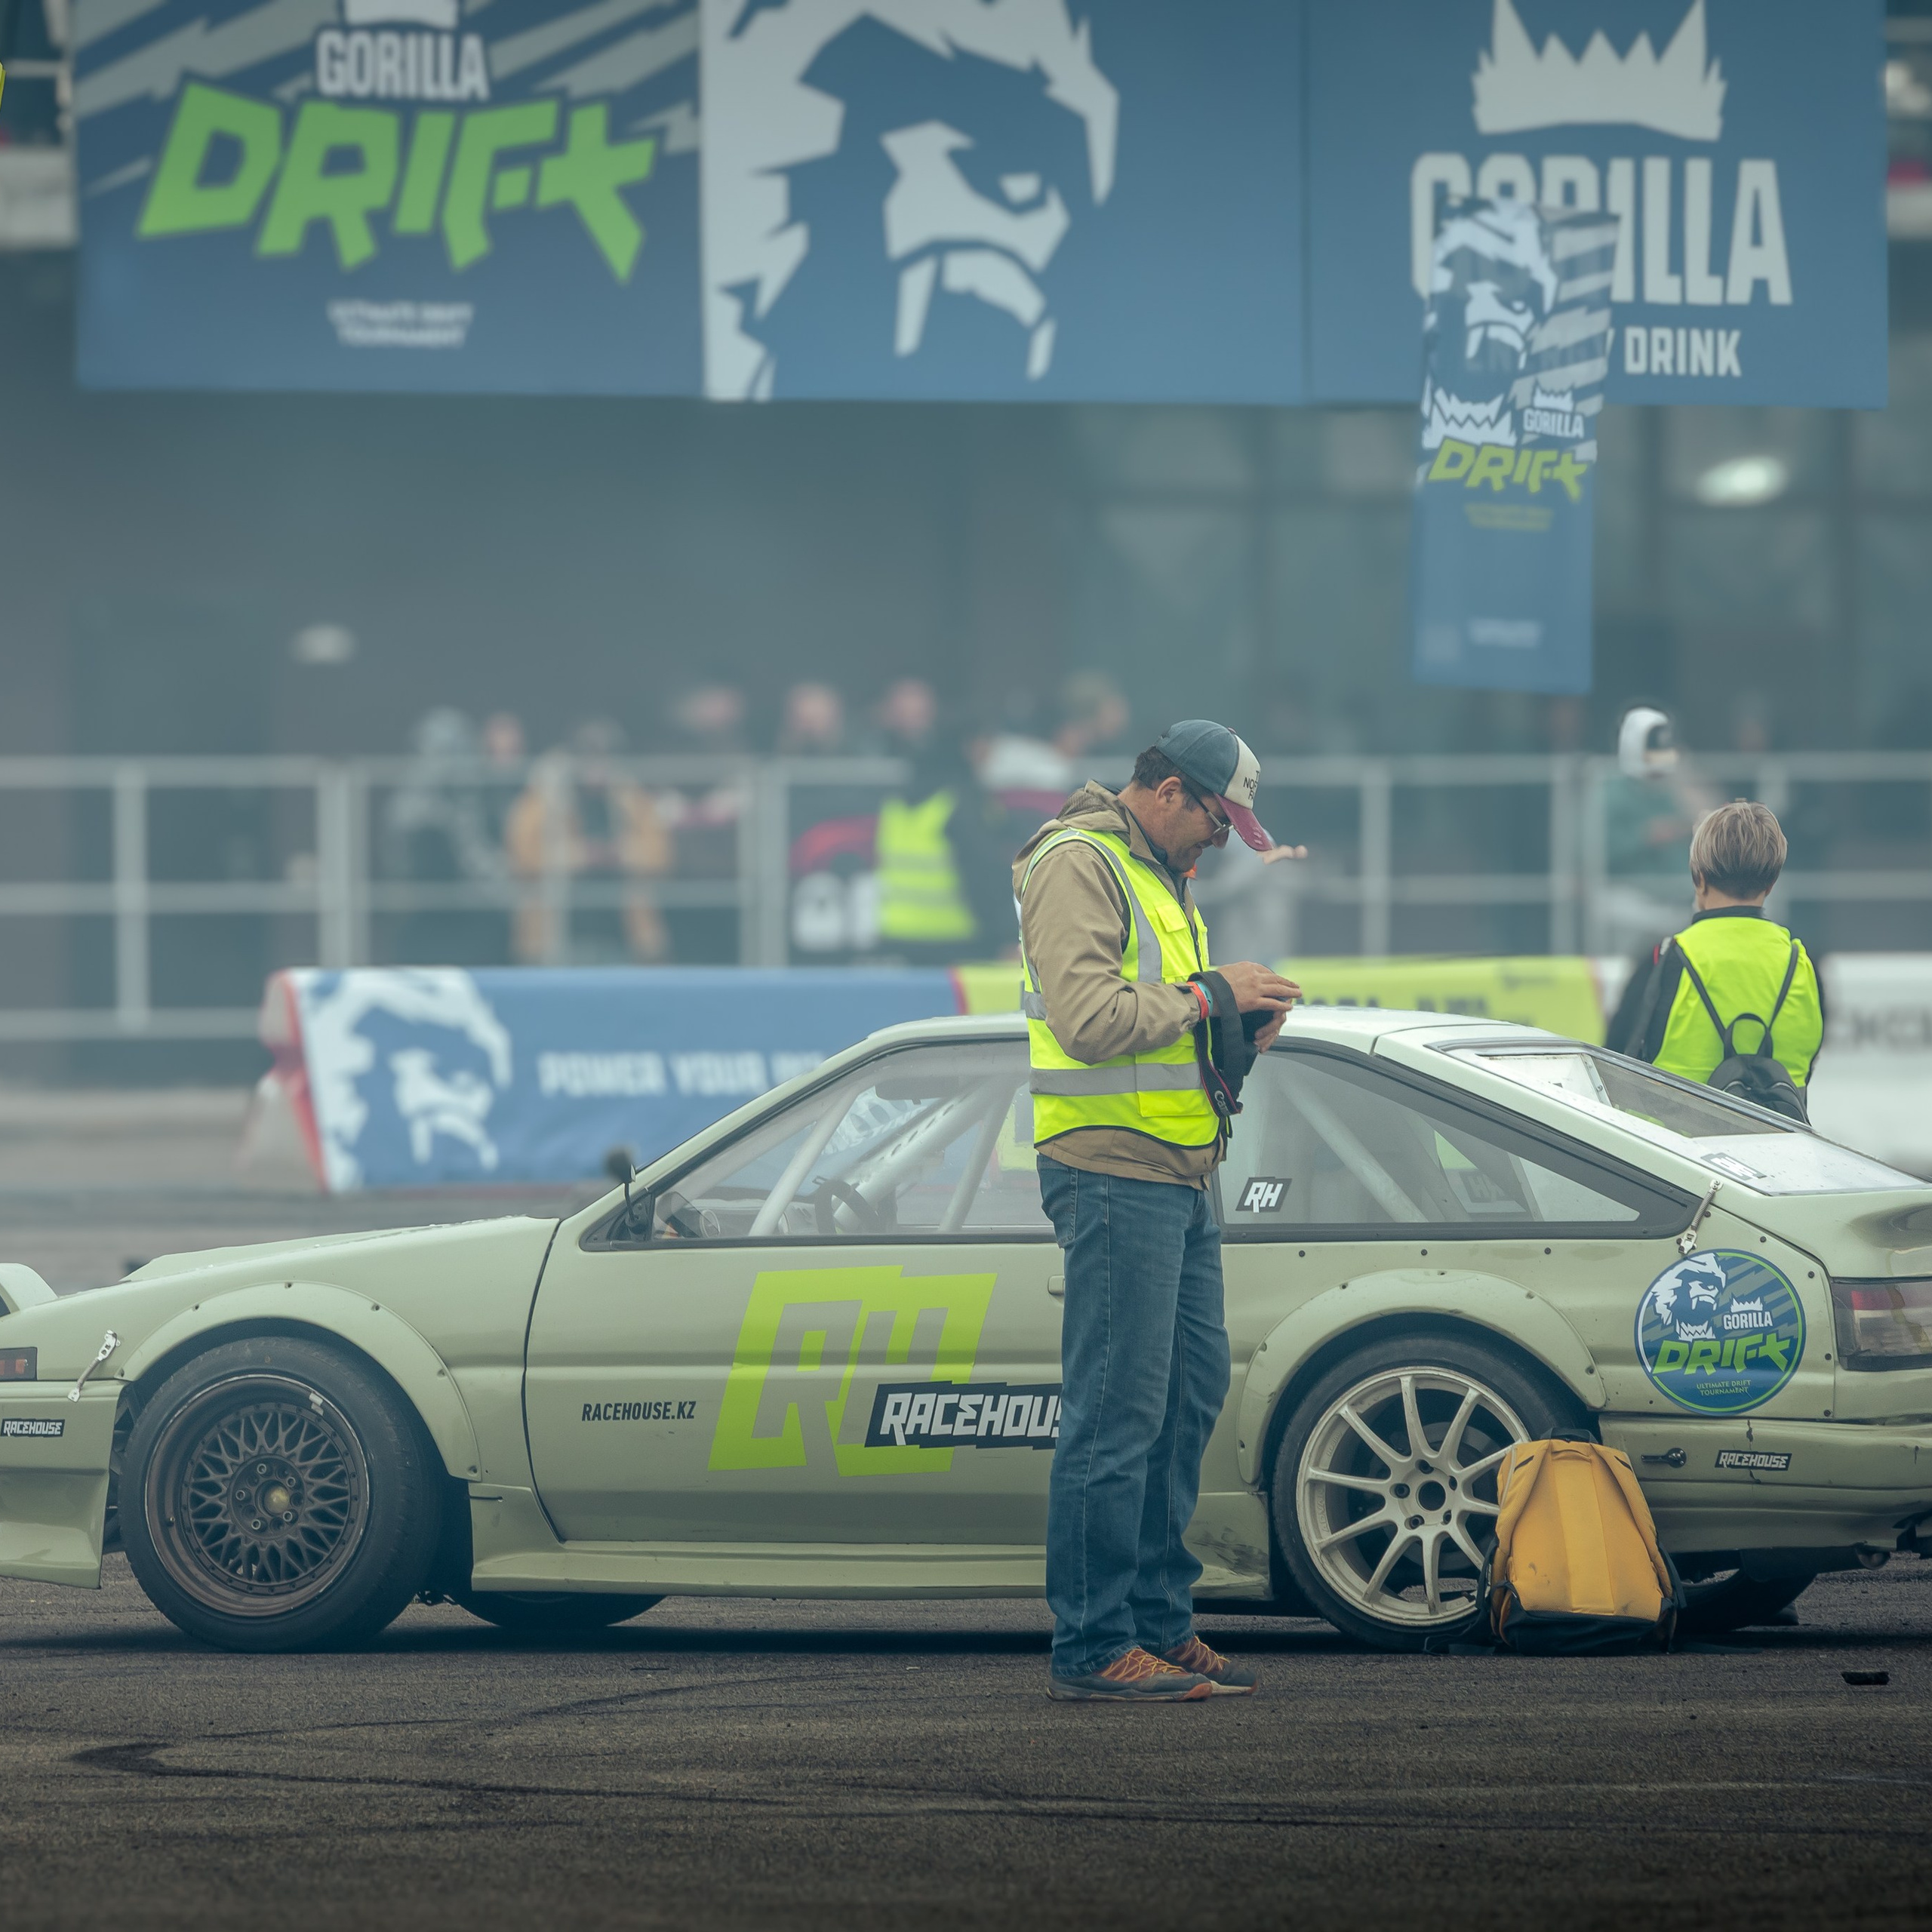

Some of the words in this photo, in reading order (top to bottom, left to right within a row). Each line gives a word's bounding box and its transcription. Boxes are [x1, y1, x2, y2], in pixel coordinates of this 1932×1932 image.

[317, 29, 490, 101] GORILLA
[137, 82, 656, 286] DRIFT
[1624, 326, 1743, 377] DRINK
[1523, 408, 1585, 439] GORILLA
[1427, 437, 1588, 503] DRIFT
[1244, 1182, 1283, 1213] RH
[1723, 1312, 1774, 1331] GORILLA
[1652, 1332, 1791, 1377] DRIFT
[1697, 1380, 1730, 1390] ULTIMATE
[1731, 1379, 1752, 1388] DRIFT
[1700, 1386, 1749, 1397] TOURNAMENT
[581, 1400, 697, 1422] RACEHOUSE.KZ
[879, 1392, 1062, 1447] RACEHOU
[3, 1420, 63, 1437] RACEHOUSE
[1718, 1451, 1789, 1469] RACEHOUSE
